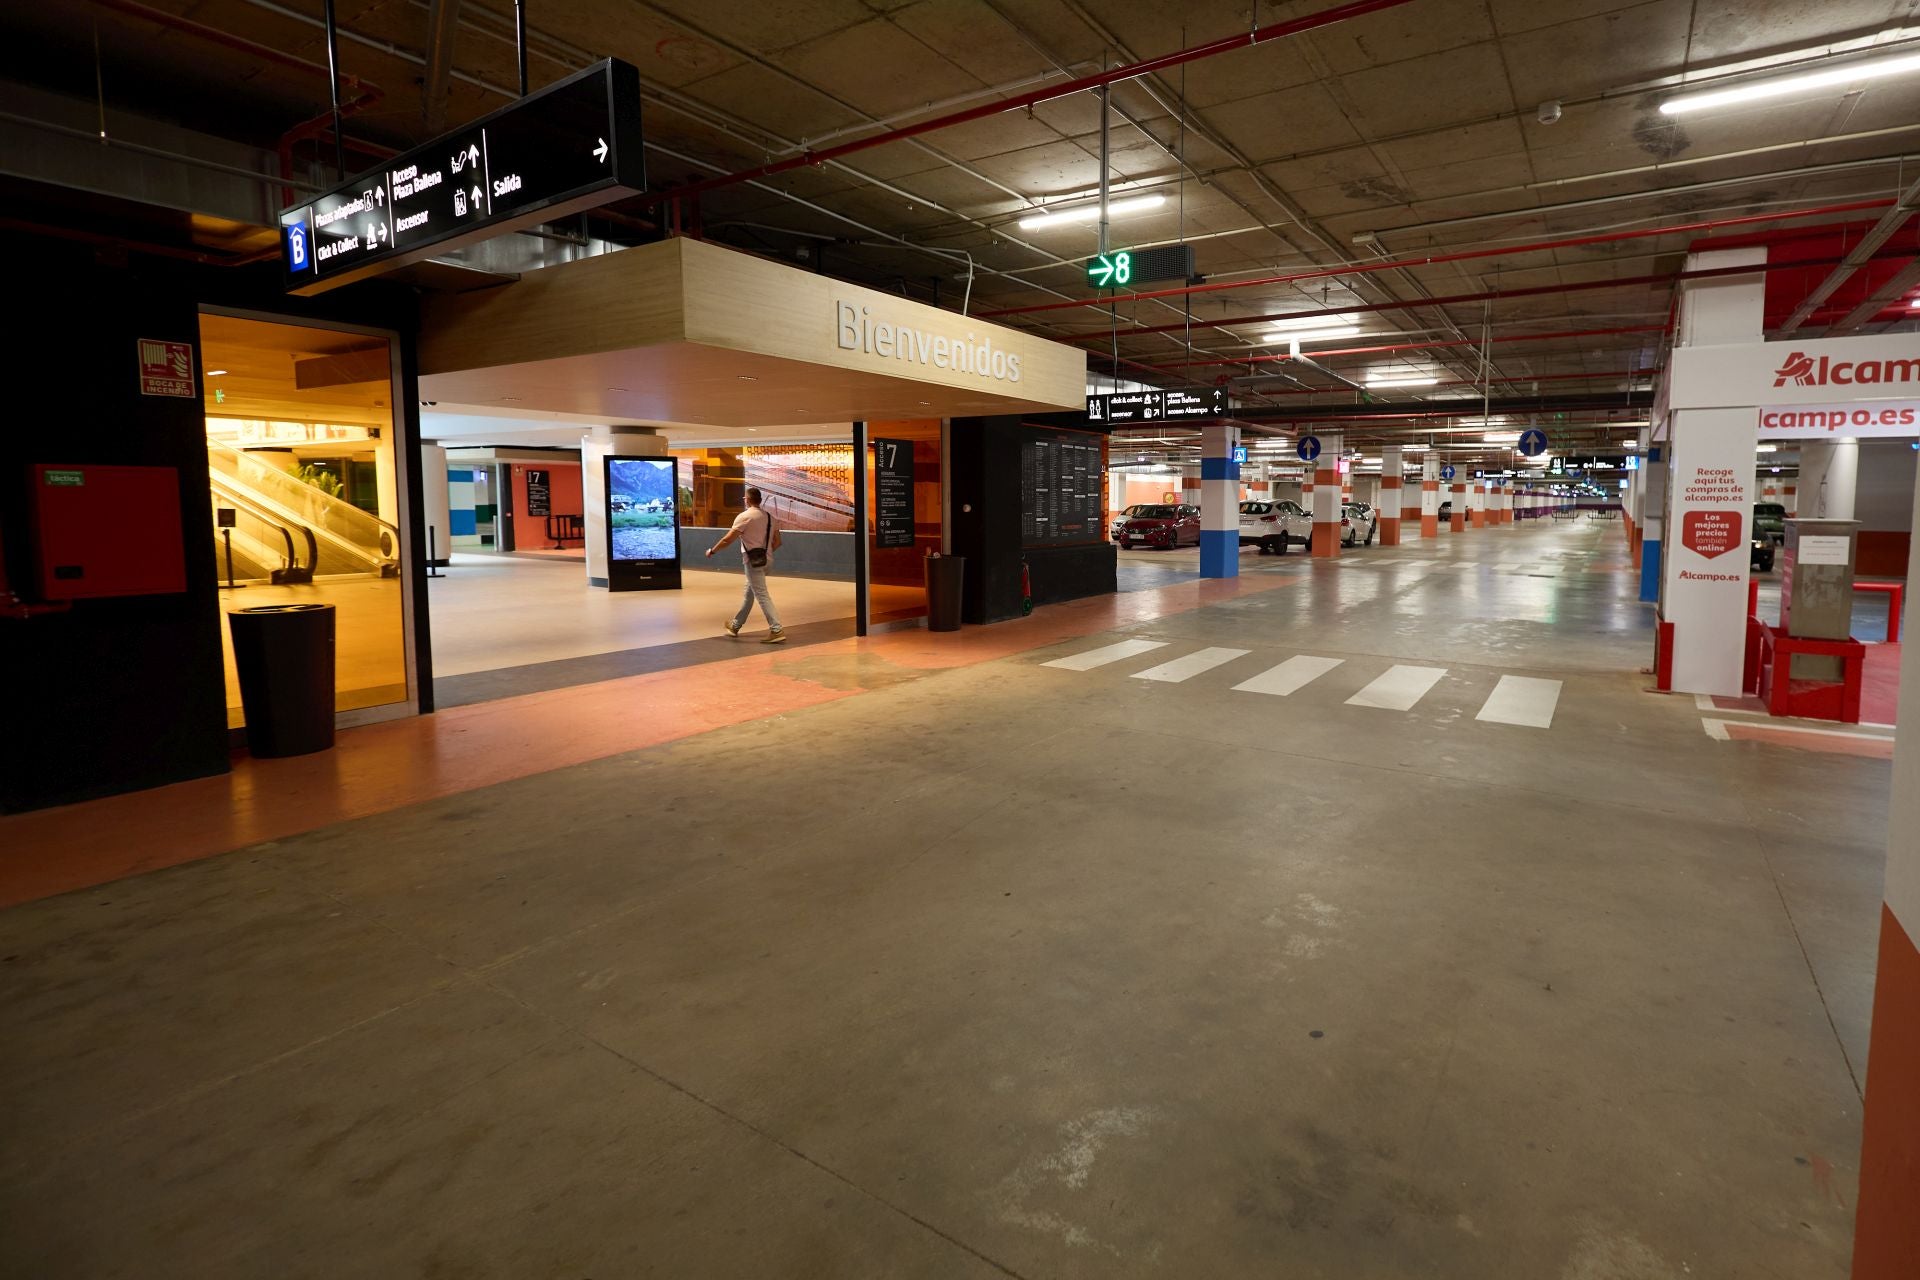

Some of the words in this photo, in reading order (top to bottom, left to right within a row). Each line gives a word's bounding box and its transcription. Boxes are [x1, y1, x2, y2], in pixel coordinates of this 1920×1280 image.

[393, 165, 417, 185] Acceso
[393, 183, 414, 200] Plaza
[413, 171, 442, 193] Ballena
[493, 173, 522, 197] Salida
[396, 210, 429, 233] Ascensor
[292, 234, 305, 265] B
[318, 245, 332, 261] Click
[332, 242, 338, 256] &
[338, 236, 359, 254] Collect
[1115, 252, 1130, 283] 8
[837, 300, 1021, 383] Bienvenidos
[146, 385, 191, 396] INCENDIO
[149, 379, 174, 388] BOCA
[175, 381, 188, 389] DE
[887, 444, 897, 469] 7
[1697, 468, 1734, 477] Recoge
[1694, 477, 1717, 486] aquí
[1730, 485, 1744, 493] de
[1684, 494, 1744, 503] alcampo.es
[1694, 522, 1730, 530] mejores
[1695, 530, 1728, 538] precios
[1679, 570, 1741, 582] Alcampo.es
